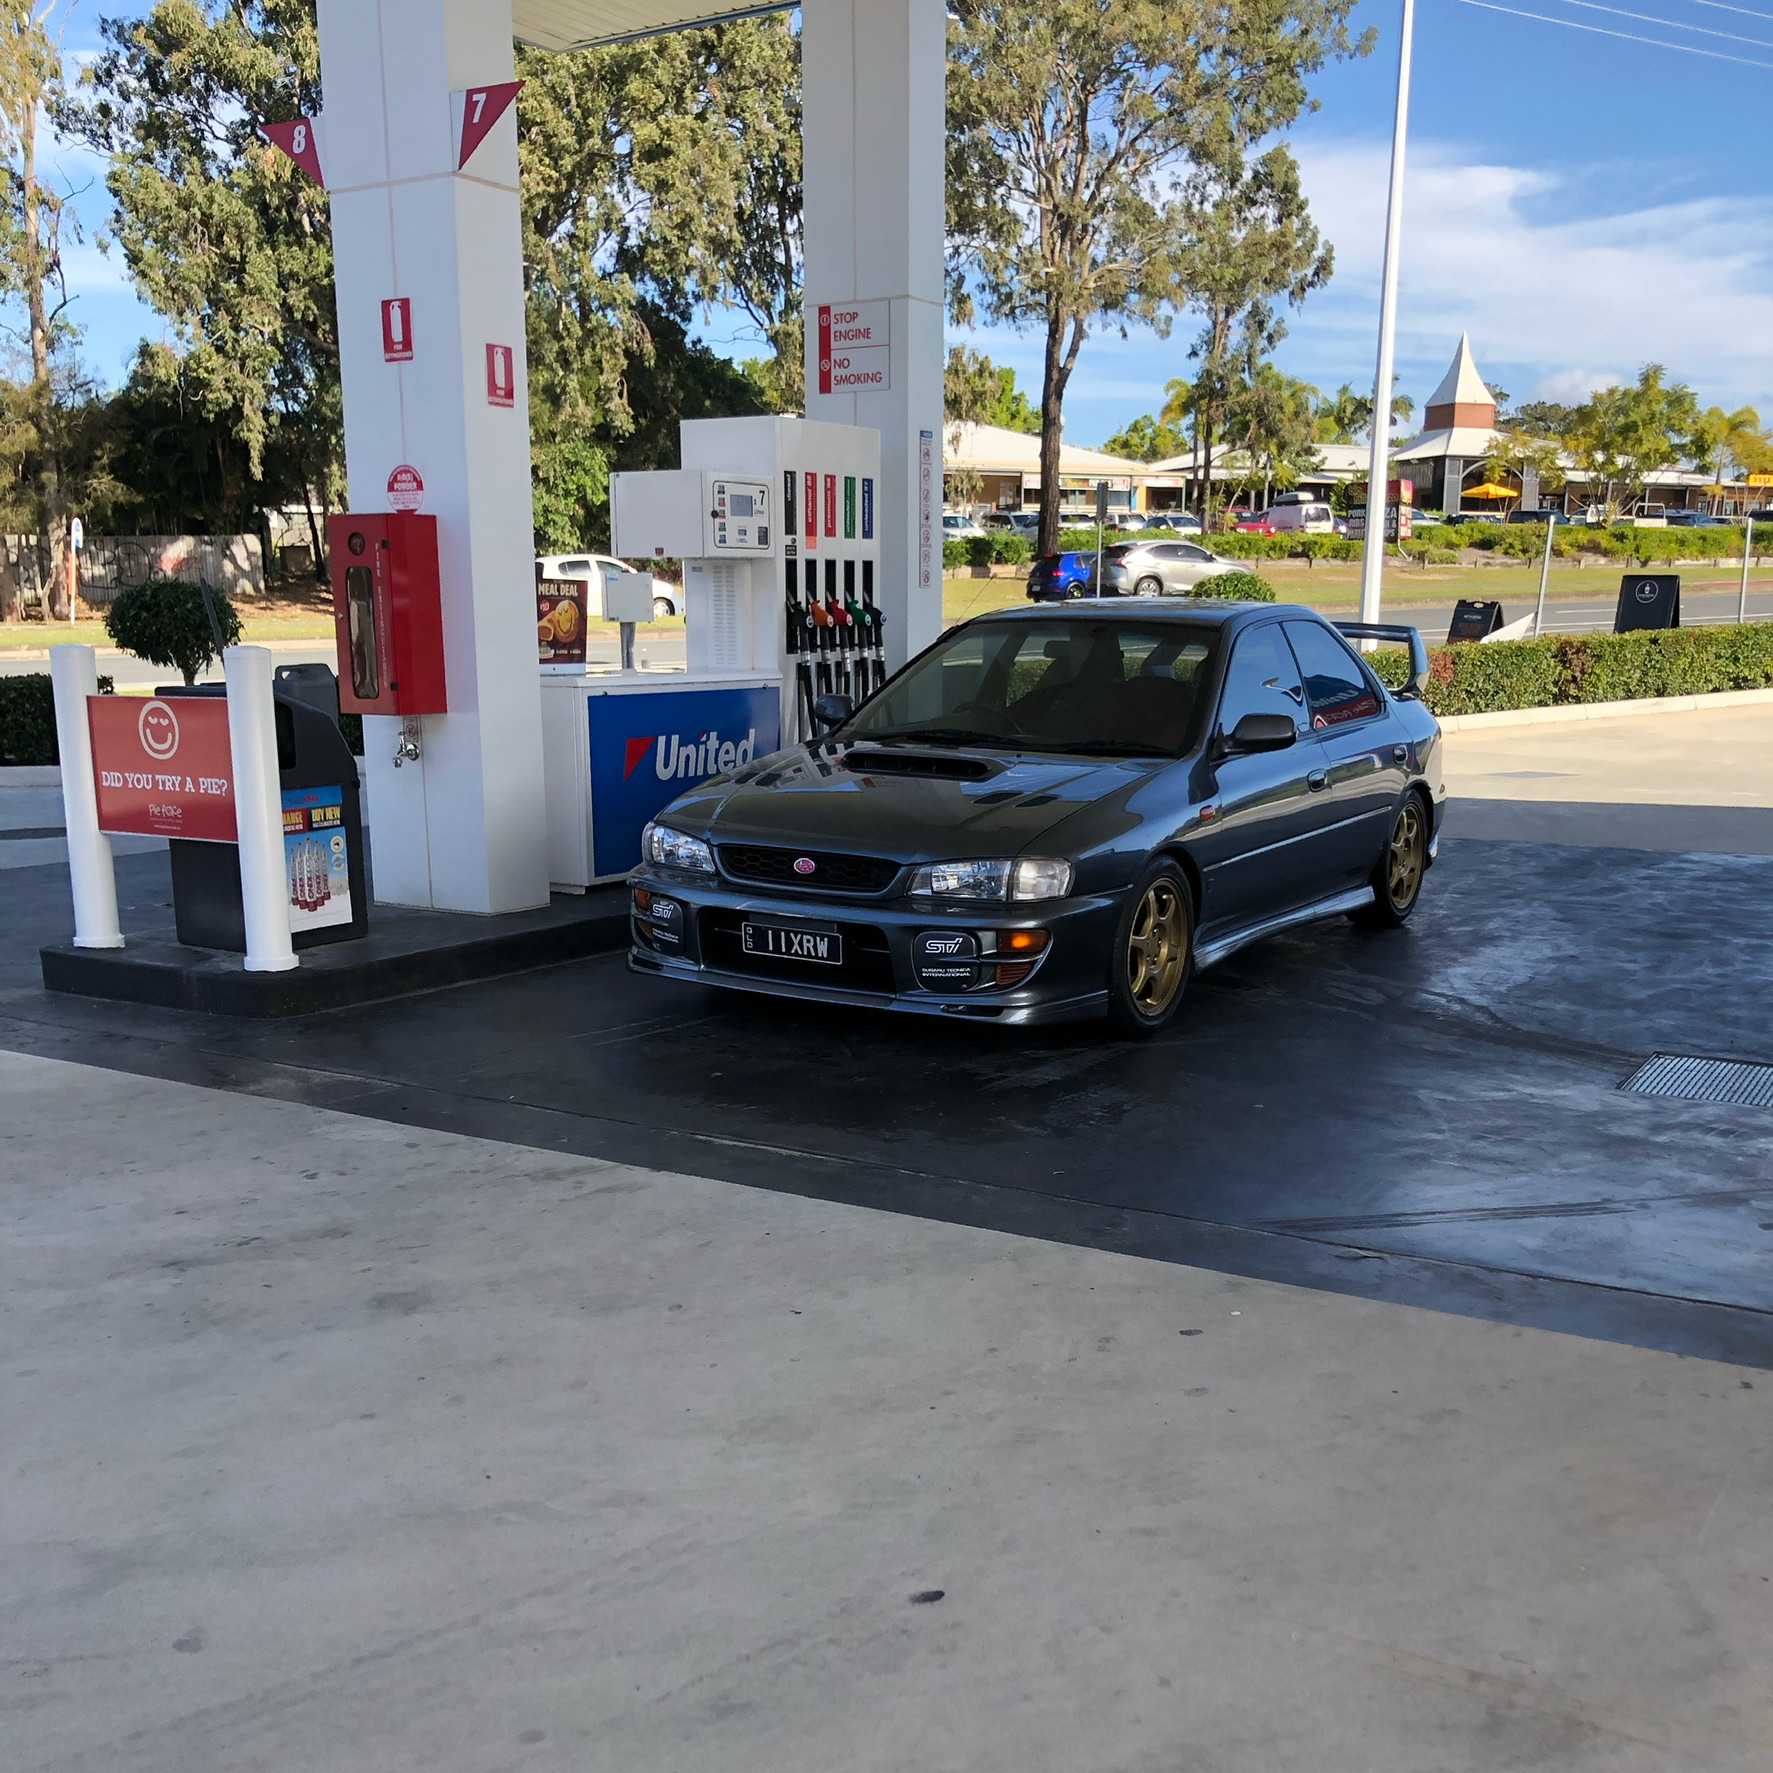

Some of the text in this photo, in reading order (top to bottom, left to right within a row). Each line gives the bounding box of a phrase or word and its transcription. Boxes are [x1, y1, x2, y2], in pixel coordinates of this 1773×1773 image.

[472, 92, 487, 123] 7
[292, 124, 306, 154] 8
[833, 311, 858, 325] STOP
[833, 327, 872, 342] ENGINE
[833, 358, 850, 370] NO
[833, 371, 883, 386] SMOKING
[759, 490, 765, 506] 7
[1348, 509, 1366, 518] PORK
[538, 582, 579, 597] MEAL DEAL
[656, 728, 756, 781] United
[101, 771, 228, 796] DID YOU TRY A PIE?
[148, 803, 182, 818] Pie face
[311, 805, 340, 822] BUY NEW
